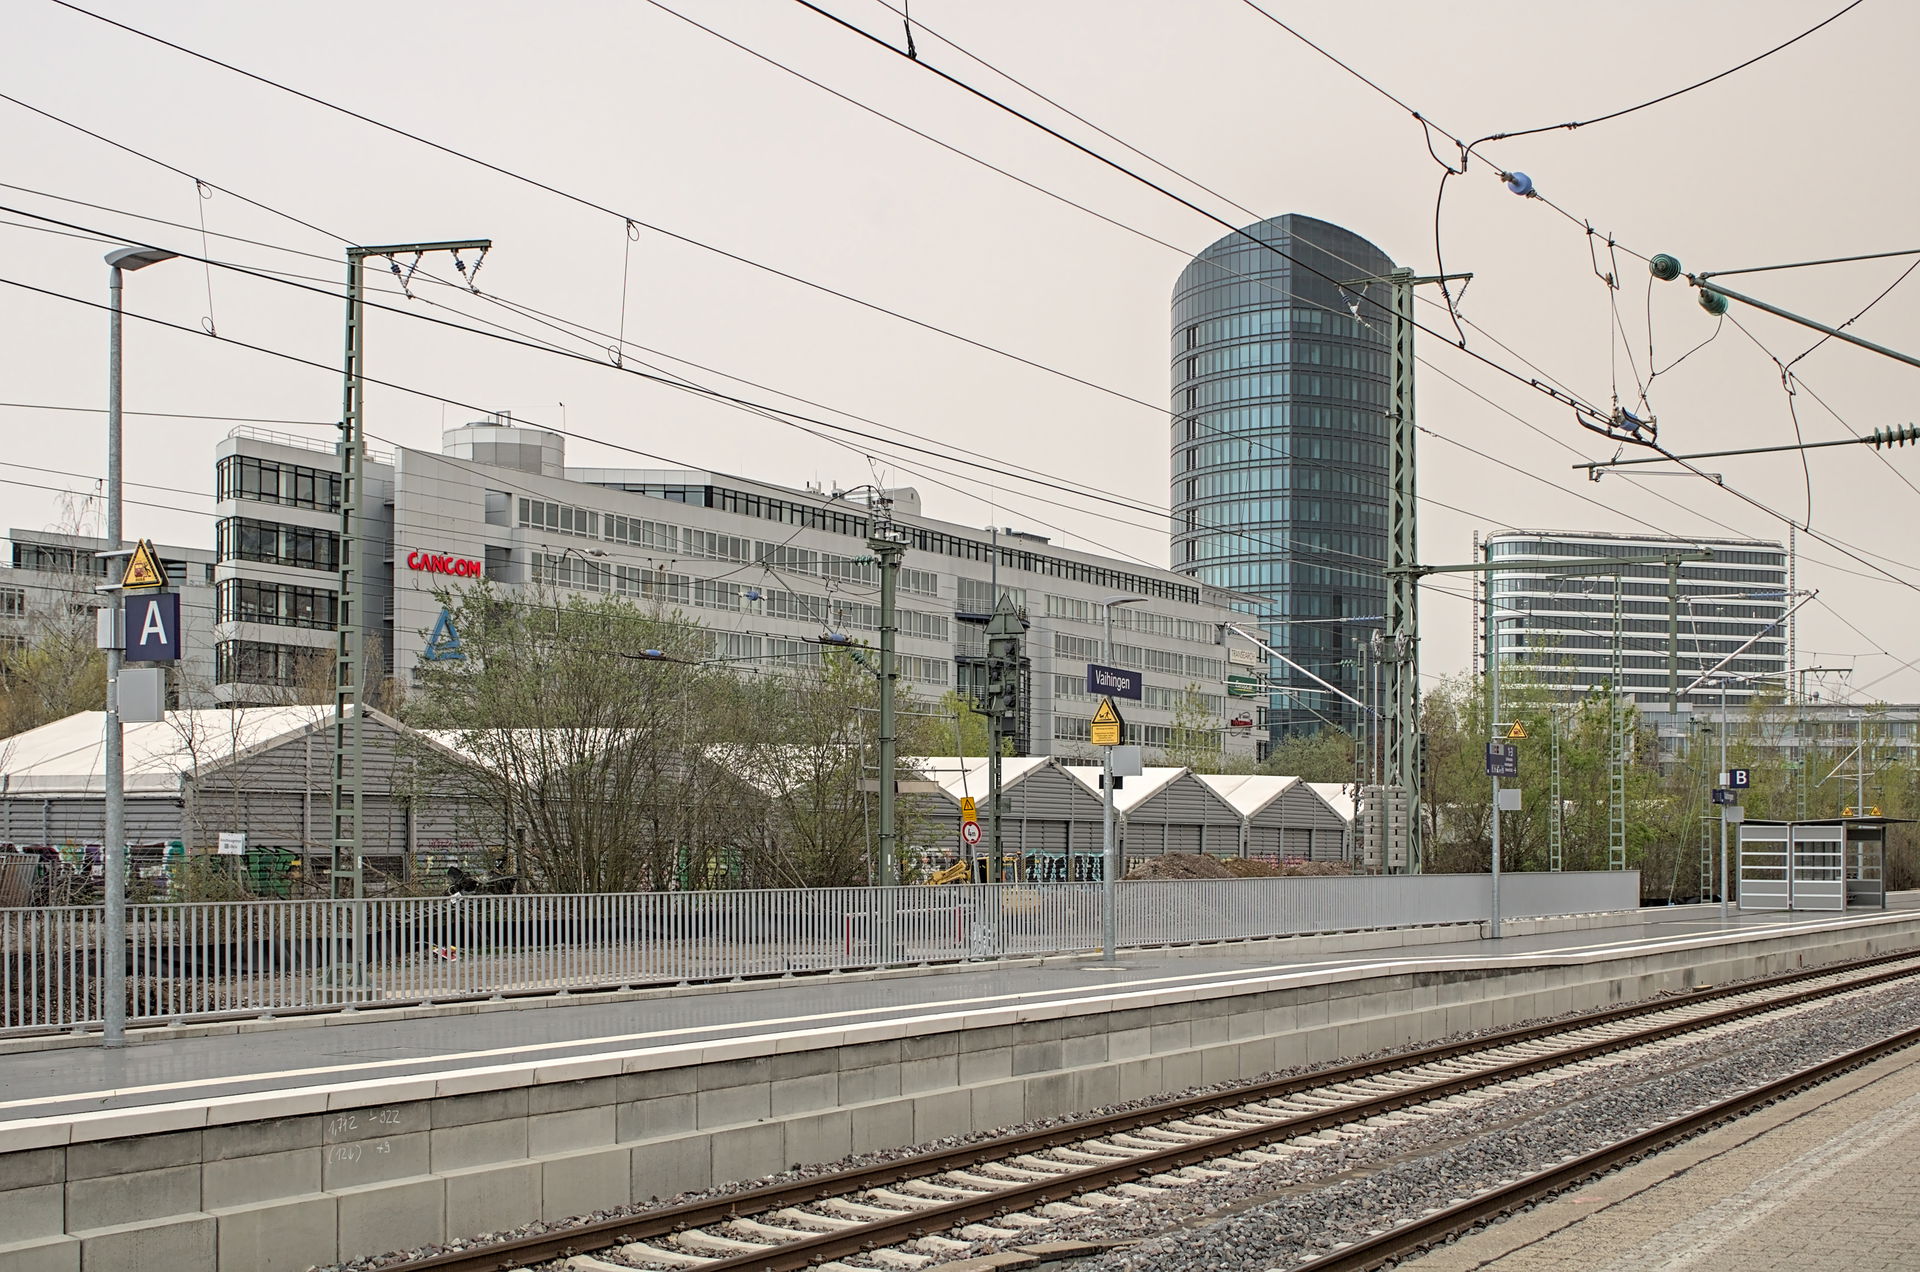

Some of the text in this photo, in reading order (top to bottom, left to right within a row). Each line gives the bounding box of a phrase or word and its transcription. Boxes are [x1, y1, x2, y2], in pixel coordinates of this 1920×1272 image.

[407, 551, 481, 577] CANCOM
[139, 600, 168, 646] A
[1095, 669, 1131, 692] Vaihingen
[1736, 770, 1748, 785] B
